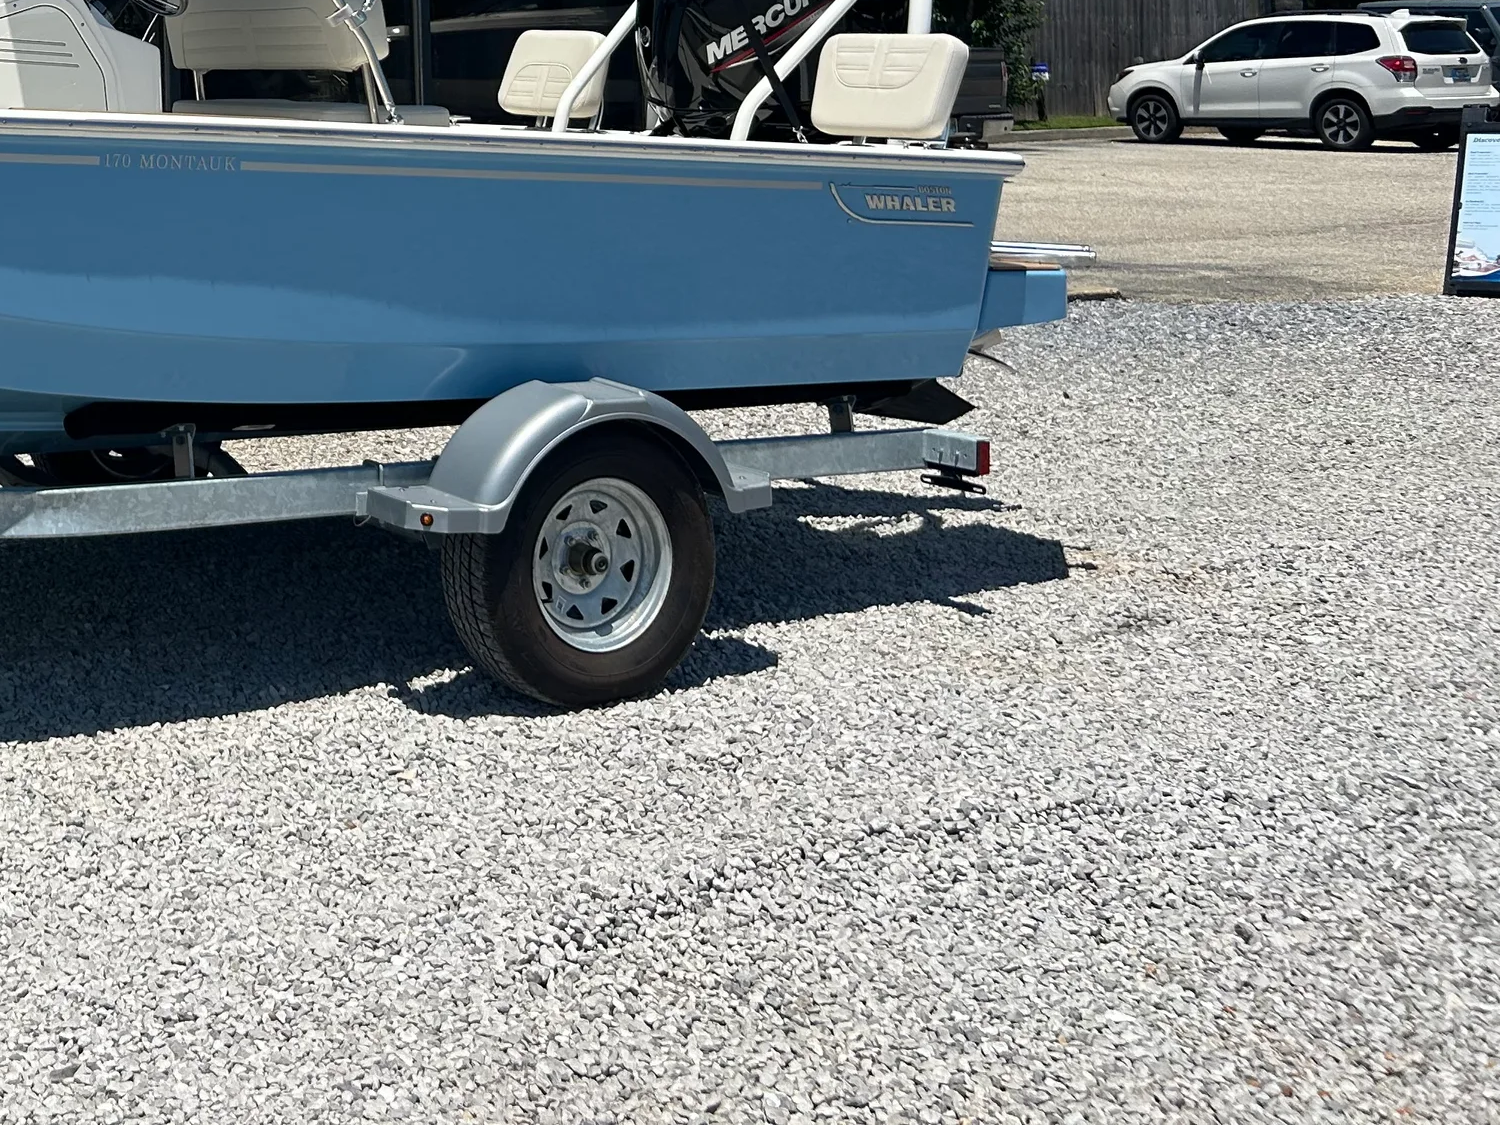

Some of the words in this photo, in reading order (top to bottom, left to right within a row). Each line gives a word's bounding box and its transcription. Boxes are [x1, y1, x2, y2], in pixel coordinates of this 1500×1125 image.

[104, 153, 132, 168] 170
[140, 154, 237, 171] MONTAUK
[917, 185, 952, 195] BOSTON
[864, 194, 956, 212] WHALER
